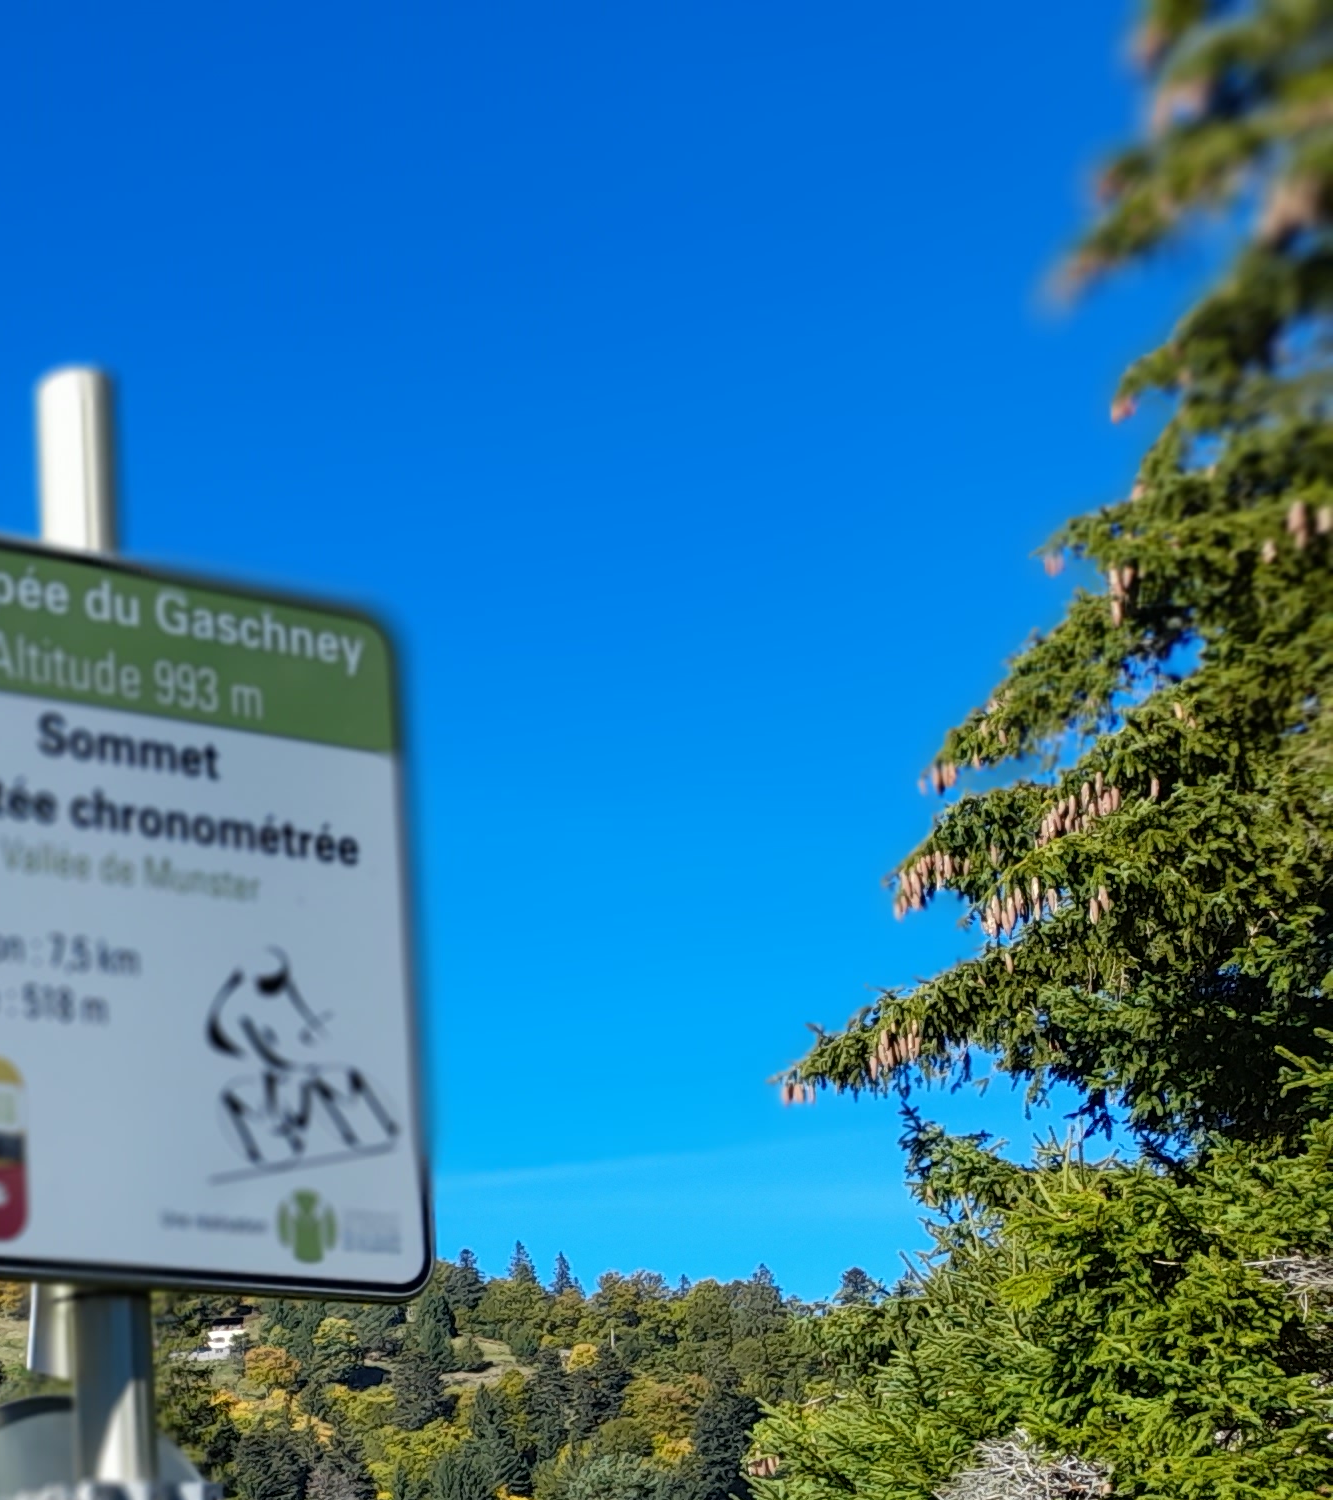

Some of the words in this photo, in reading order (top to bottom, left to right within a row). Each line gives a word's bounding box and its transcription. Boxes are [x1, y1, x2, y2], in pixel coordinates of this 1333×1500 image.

[85, 580, 140, 625] du
[154, 589, 364, 676] Gaschney
[153, 659, 219, 712] 993
[231, 682, 263, 721] m
[37, 711, 222, 782] Sommet
[69, 788, 361, 867] chronométrée
[0, 834, 91, 881] Vallée
[98, 851, 135, 887] de
[143, 855, 261, 898] Munster
[49, 930, 91, 977] 7,5
[97, 937, 141, 977] km
[22, 982, 75, 1023] 518
[81, 991, 109, 1026] m
